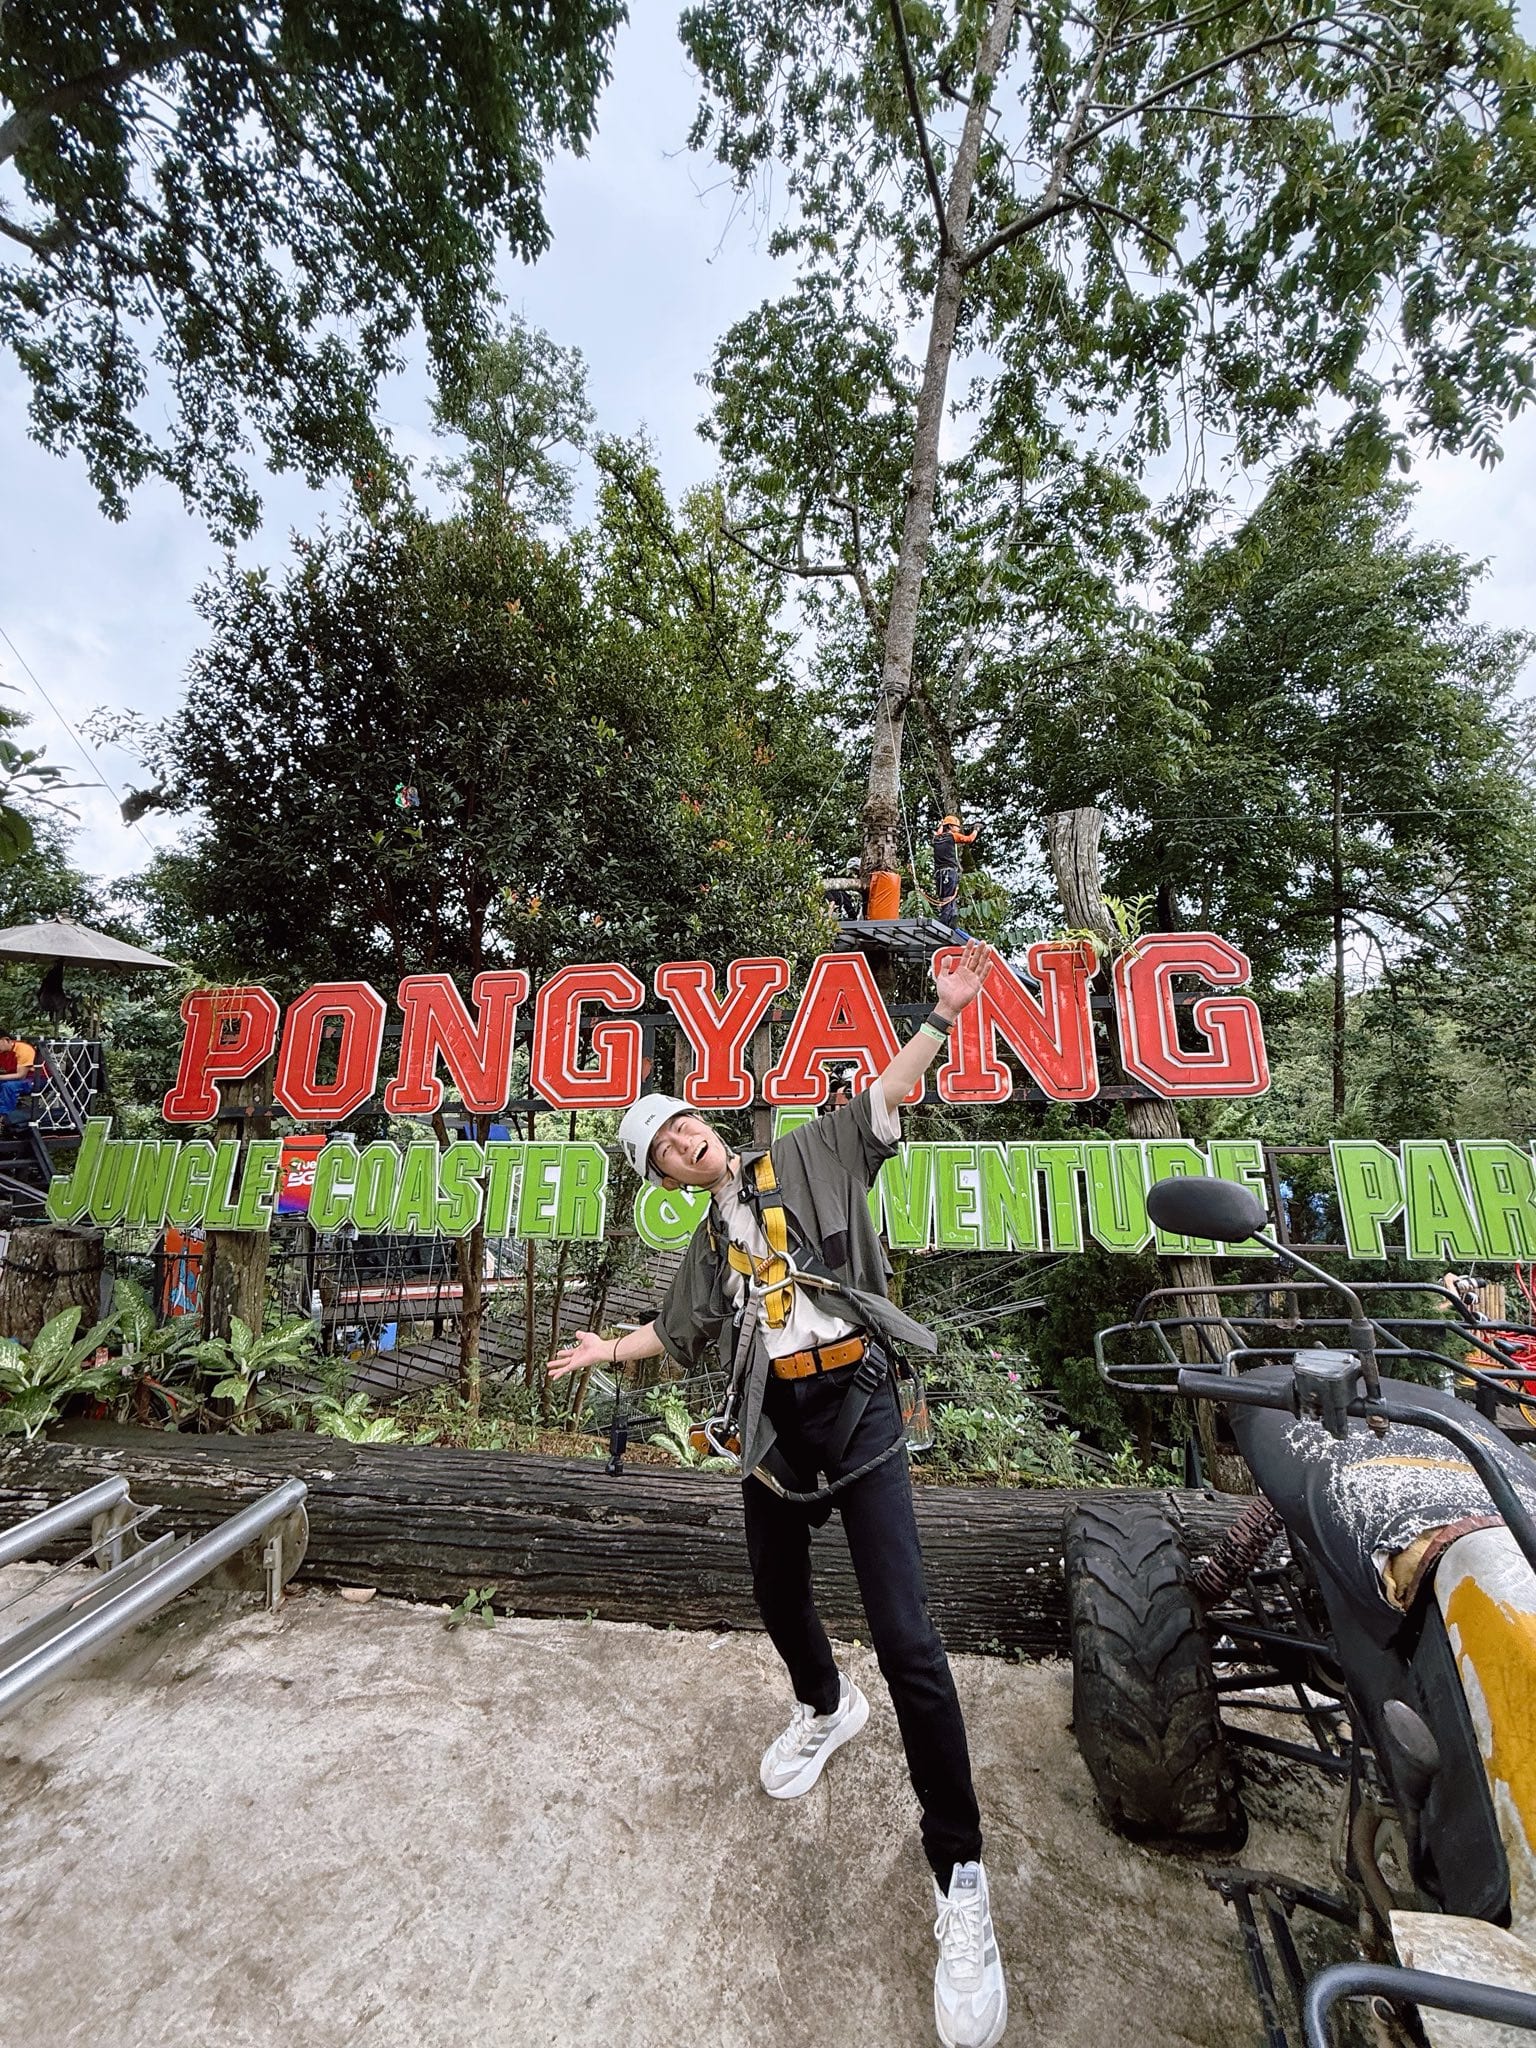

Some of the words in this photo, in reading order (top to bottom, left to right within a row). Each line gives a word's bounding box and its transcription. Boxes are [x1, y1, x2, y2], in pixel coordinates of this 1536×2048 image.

[163, 932, 1271, 1122] PONGYANG
[46, 1116, 283, 1232] JUNGLE
[308, 1139, 609, 1241] COASTER
[1329, 1139, 1536, 1262] PAR
[286, 1170, 315, 1188] 5G
